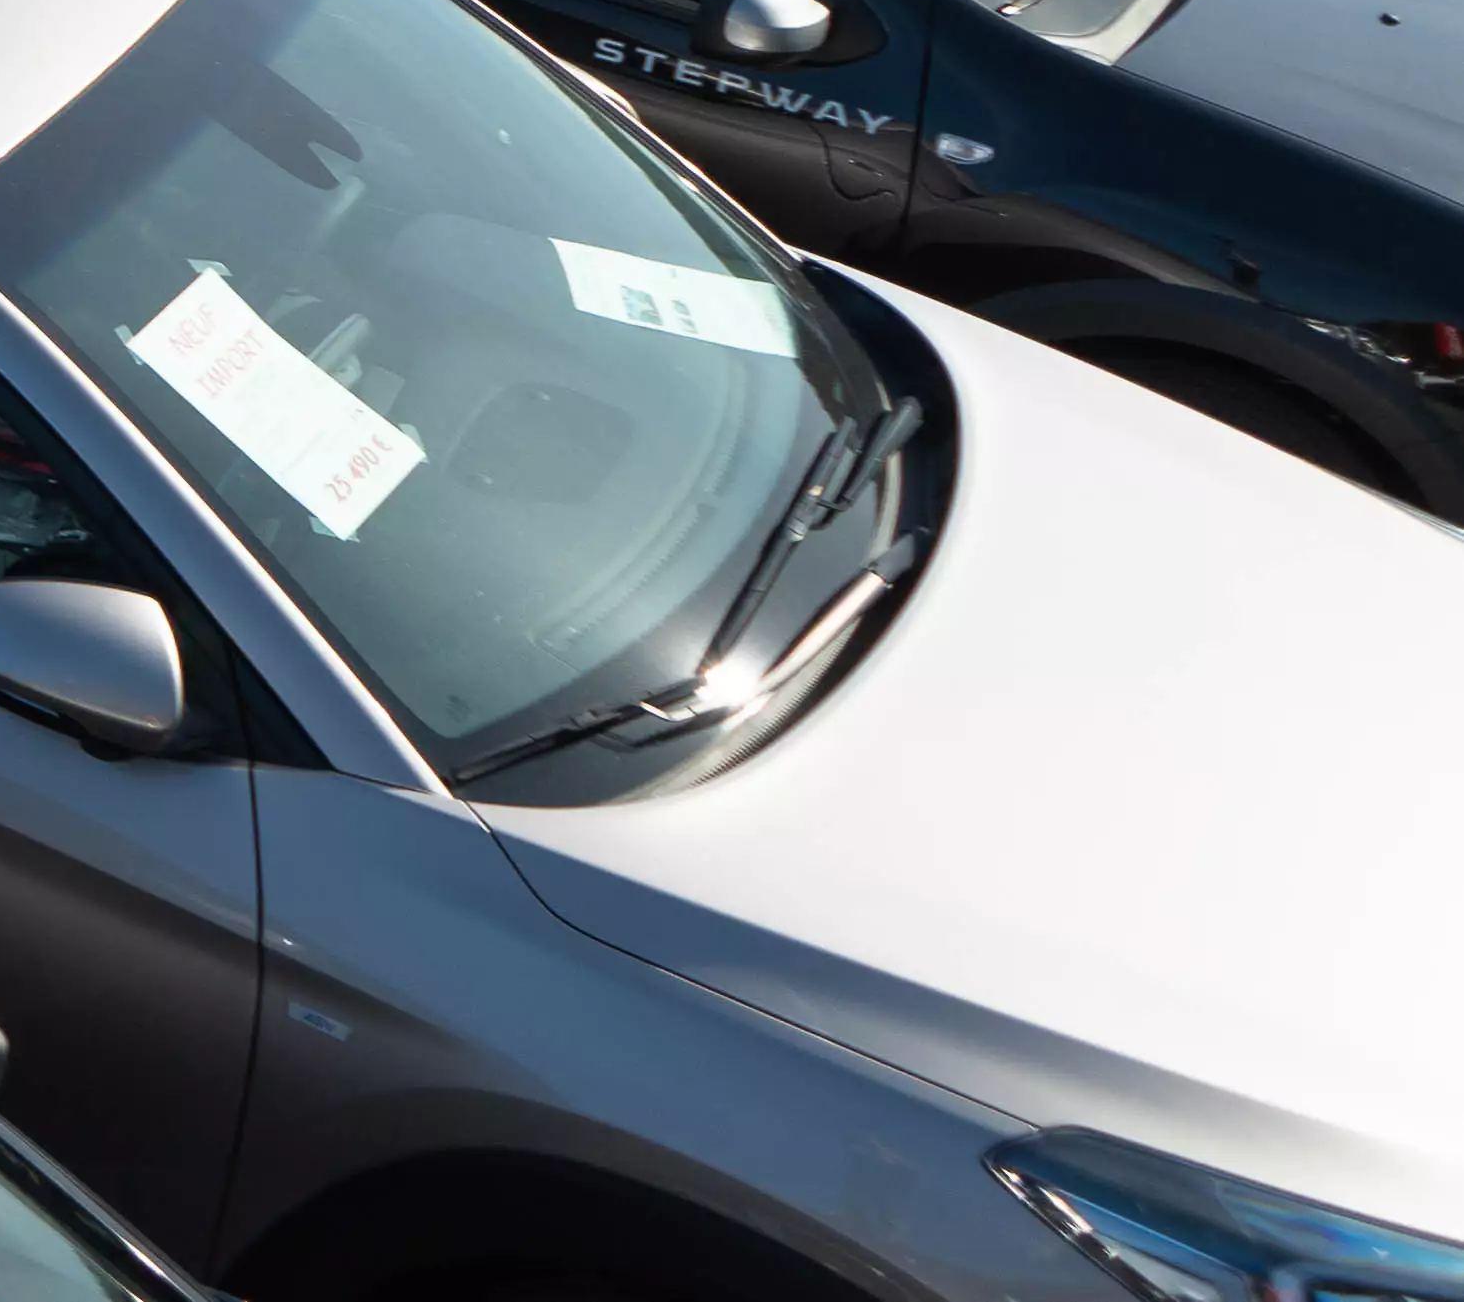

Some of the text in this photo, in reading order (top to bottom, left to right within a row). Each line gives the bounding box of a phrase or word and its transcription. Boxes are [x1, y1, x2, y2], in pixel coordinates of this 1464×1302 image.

[594, 37, 893, 135] STEPWAY
[167, 302, 216, 355] NEUF
[196, 329, 266, 400] IMPORT
[324, 478, 352, 503] 25
